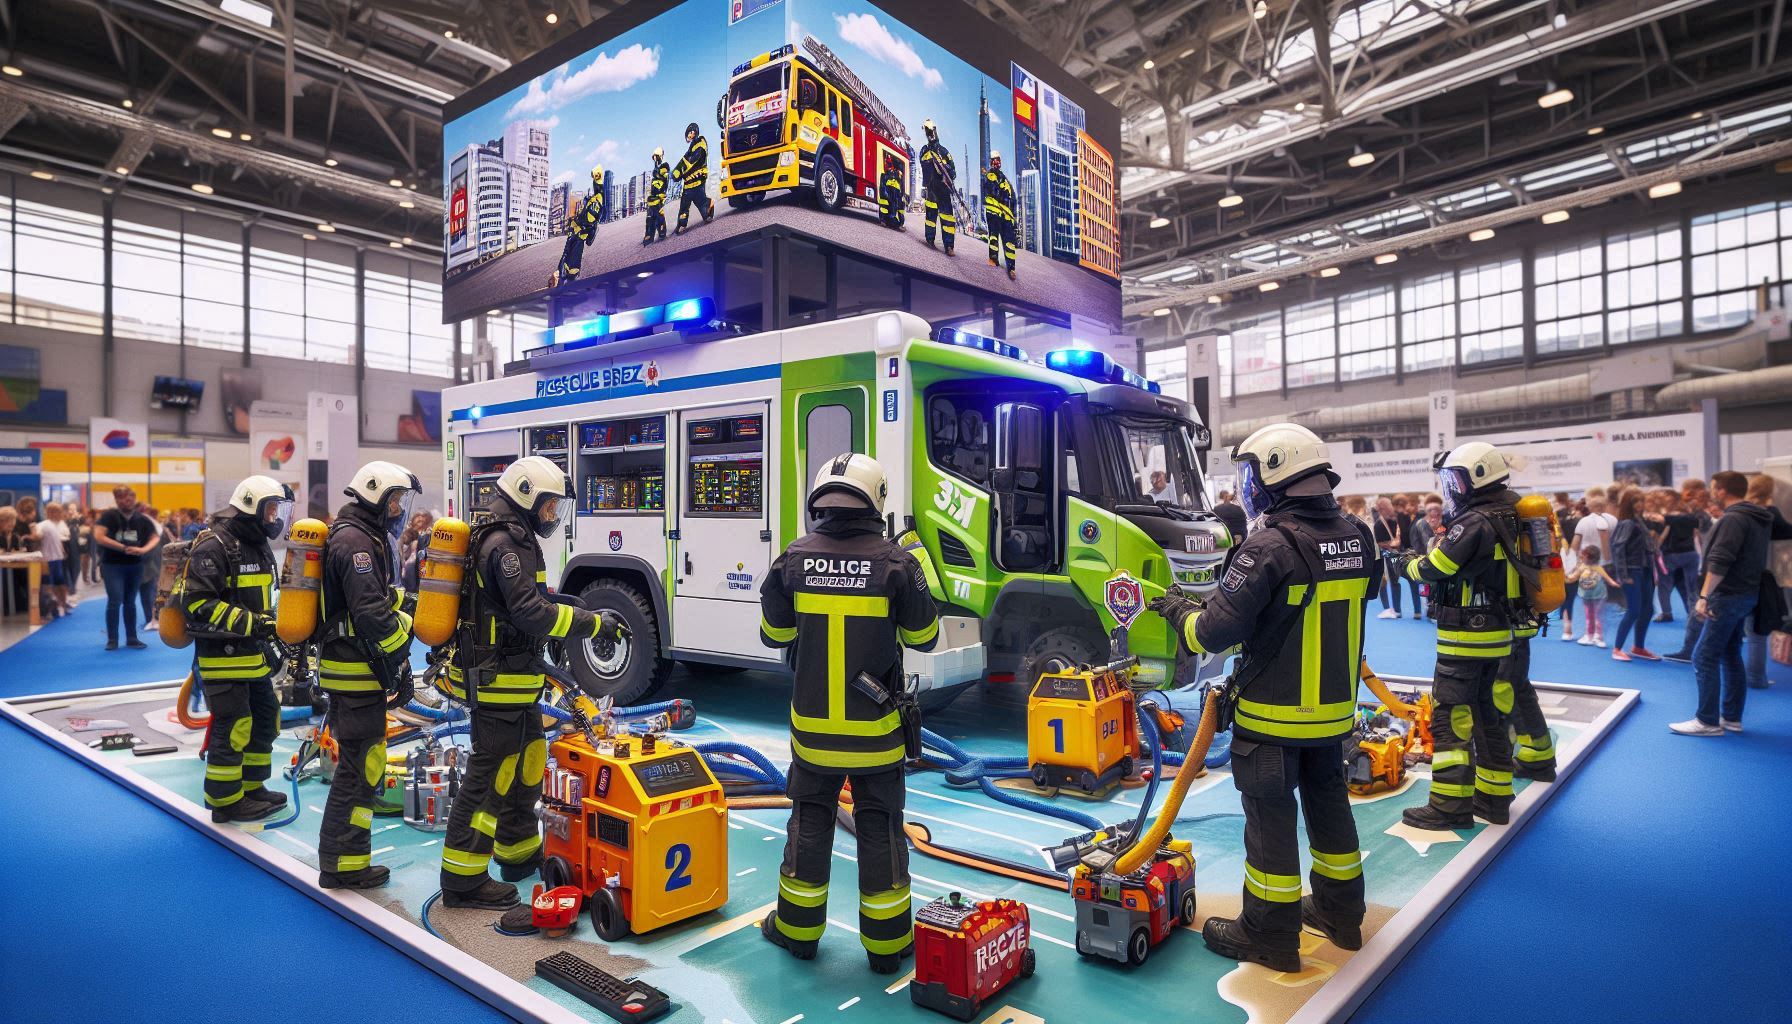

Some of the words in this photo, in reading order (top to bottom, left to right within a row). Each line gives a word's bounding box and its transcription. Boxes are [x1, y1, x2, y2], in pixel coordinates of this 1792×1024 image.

[803, 558, 872, 575] POLICE
[1047, 718, 1064, 753] 1
[664, 843, 692, 892] 2
